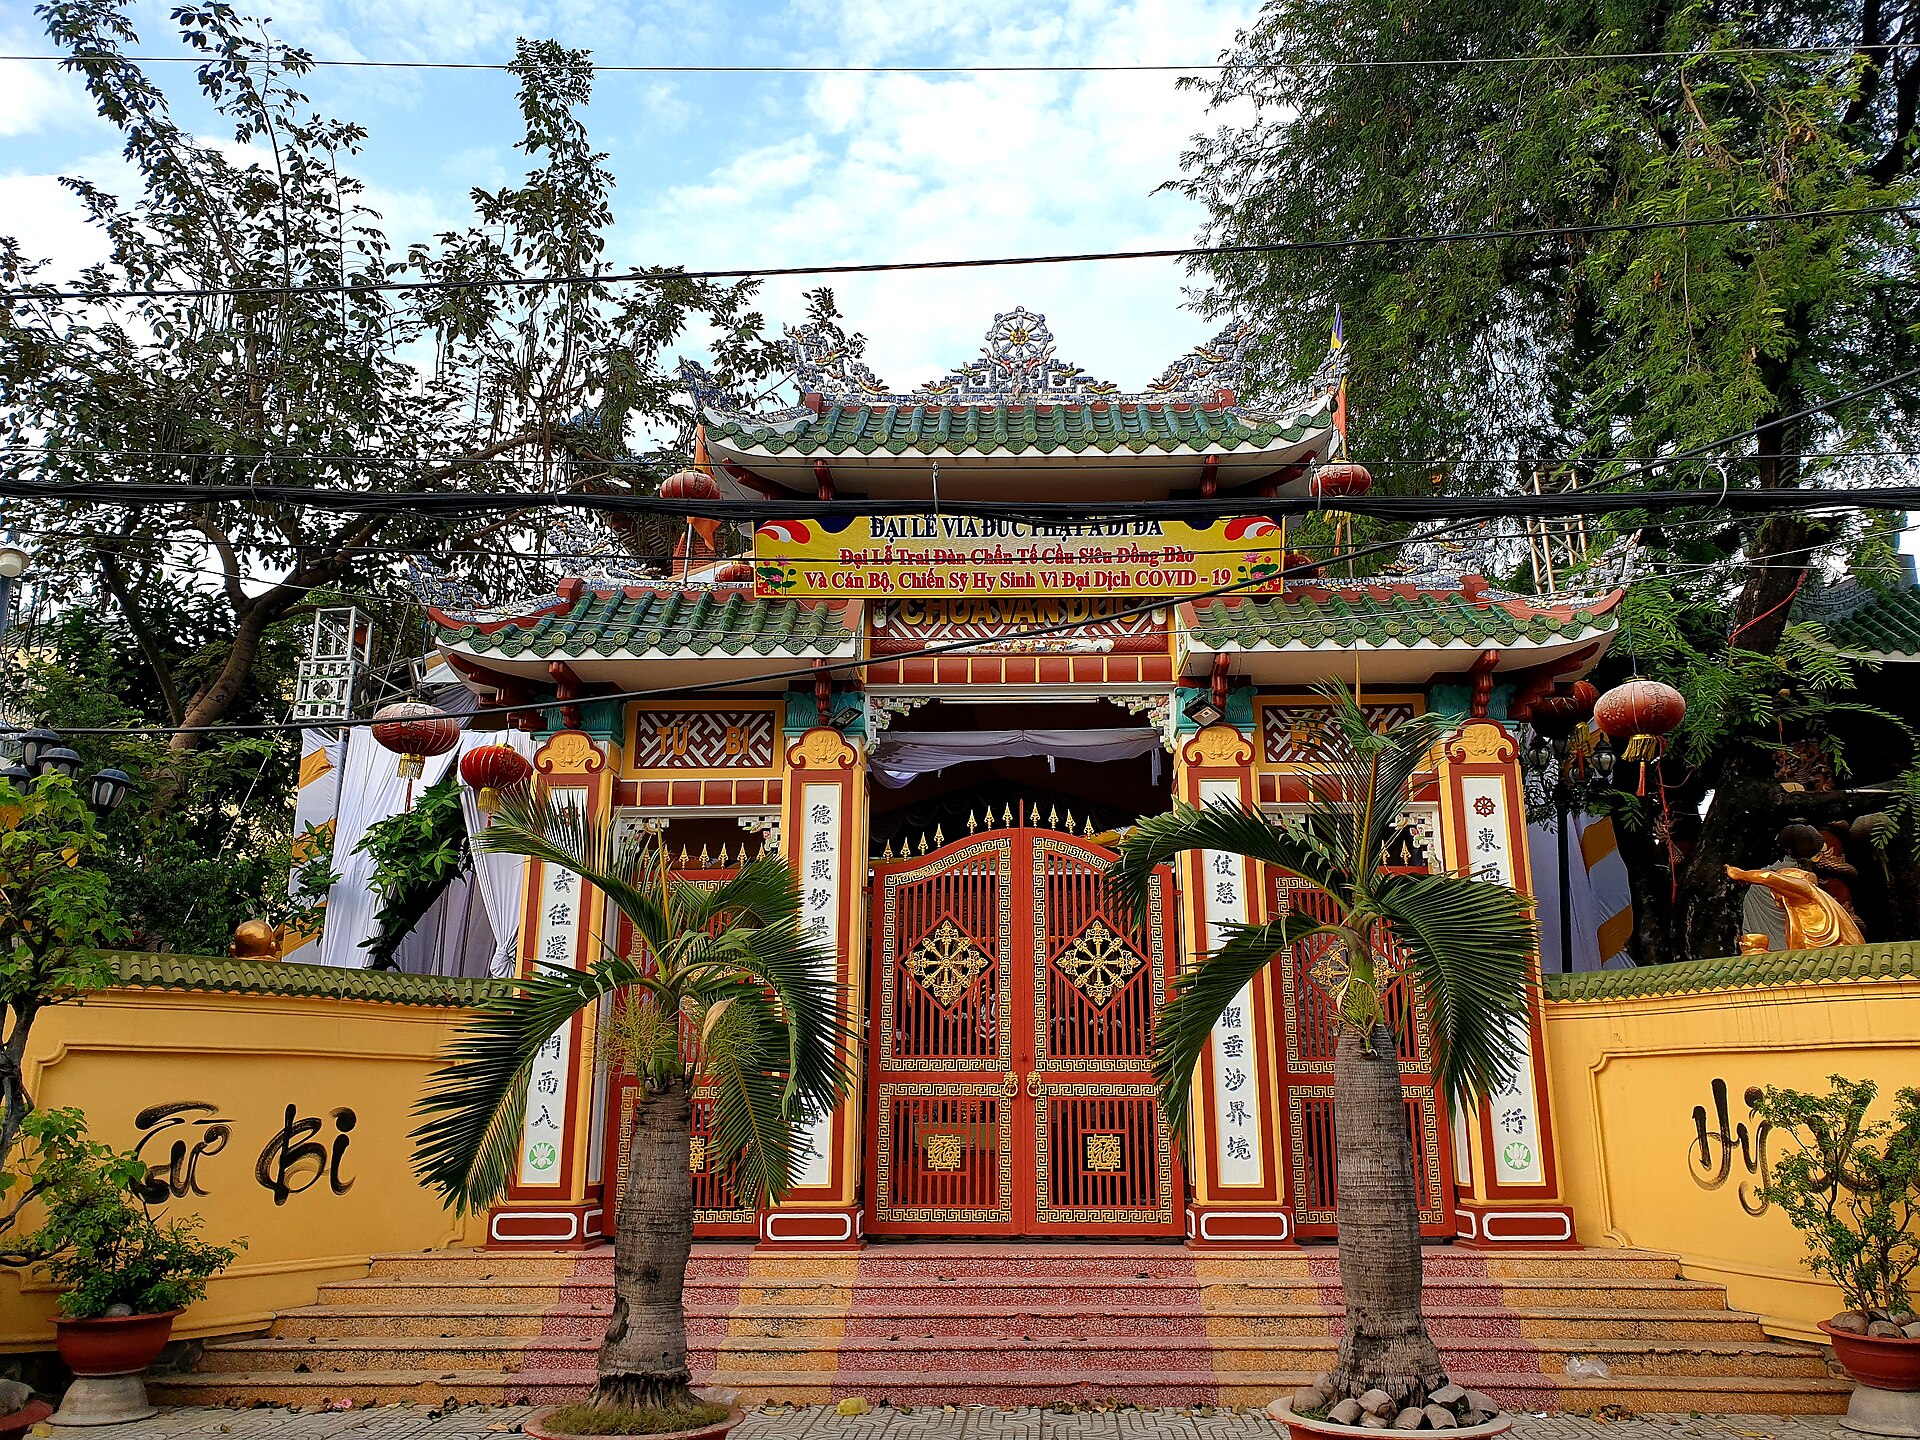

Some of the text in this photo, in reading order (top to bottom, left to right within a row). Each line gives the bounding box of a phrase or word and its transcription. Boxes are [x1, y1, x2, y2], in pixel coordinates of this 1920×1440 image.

[870, 516, 908, 543] ĐẠI
[840, 548, 867, 569] Đại
[896, 548, 929, 565] Trai
[933, 548, 966, 565] Đàn
[1163, 546, 1195, 563] Bào
[804, 571, 829, 589] Và
[831, 571, 865, 589] Cán
[899, 568, 946, 589] Chiến
[972, 571, 997, 592] Hy
[1000, 570, 1037, 588] Sinh
[1040, 570, 1058, 588] Vì
[1061, 570, 1090, 592] Đại
[1094, 569, 1131, 592] Dịch
[1135, 569, 1198, 588] COVID
[1212, 568, 1231, 586] 19
[726, 726, 750, 755] BI
[254, 1102, 357, 1207] Bi
